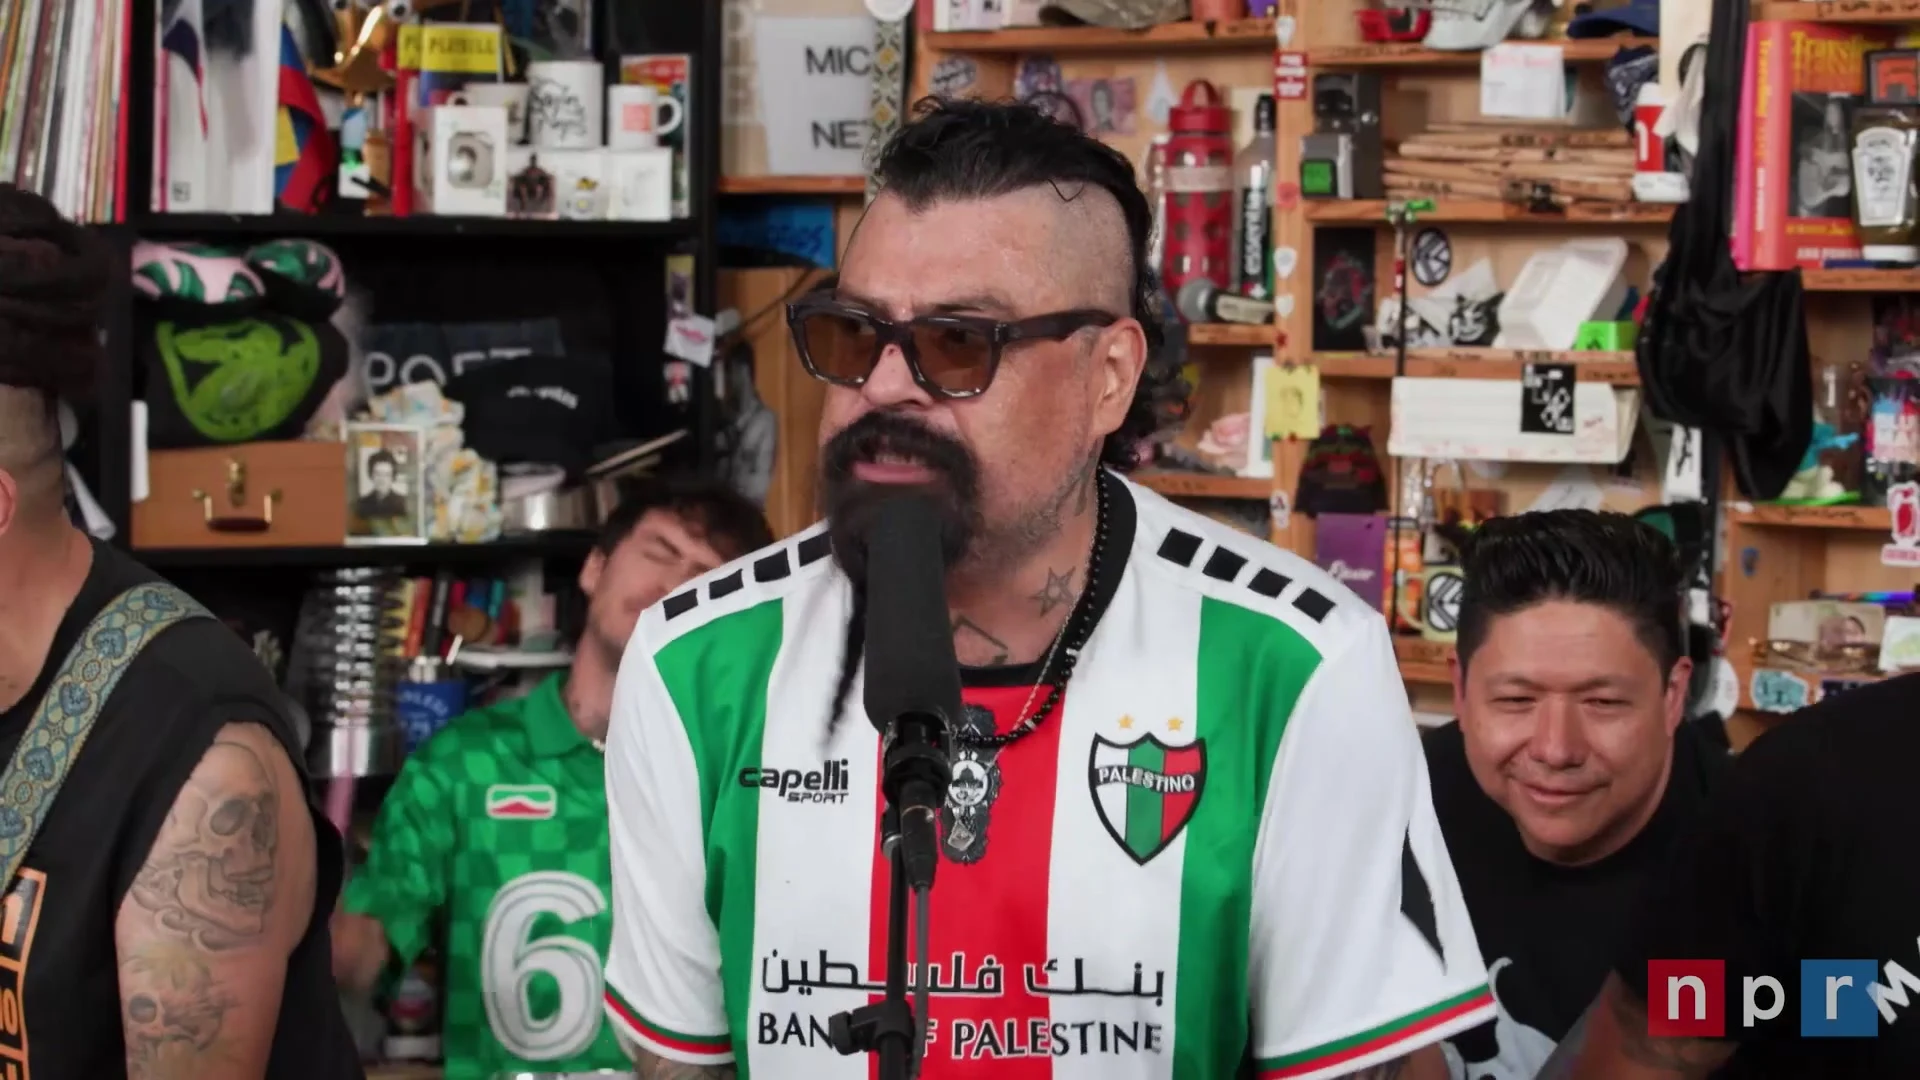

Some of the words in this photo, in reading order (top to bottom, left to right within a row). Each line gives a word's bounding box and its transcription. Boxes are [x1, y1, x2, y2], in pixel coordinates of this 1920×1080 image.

[810, 119, 869, 149] NE
[738, 759, 849, 797] capelli
[1098, 767, 1196, 793] PALESTINO
[786, 791, 850, 804] SPORT
[484, 871, 607, 1060] 6
[1865, 935, 1920, 1026] M
[757, 1012, 834, 1050] BAN
[952, 1017, 1163, 1060] PALESTINE
